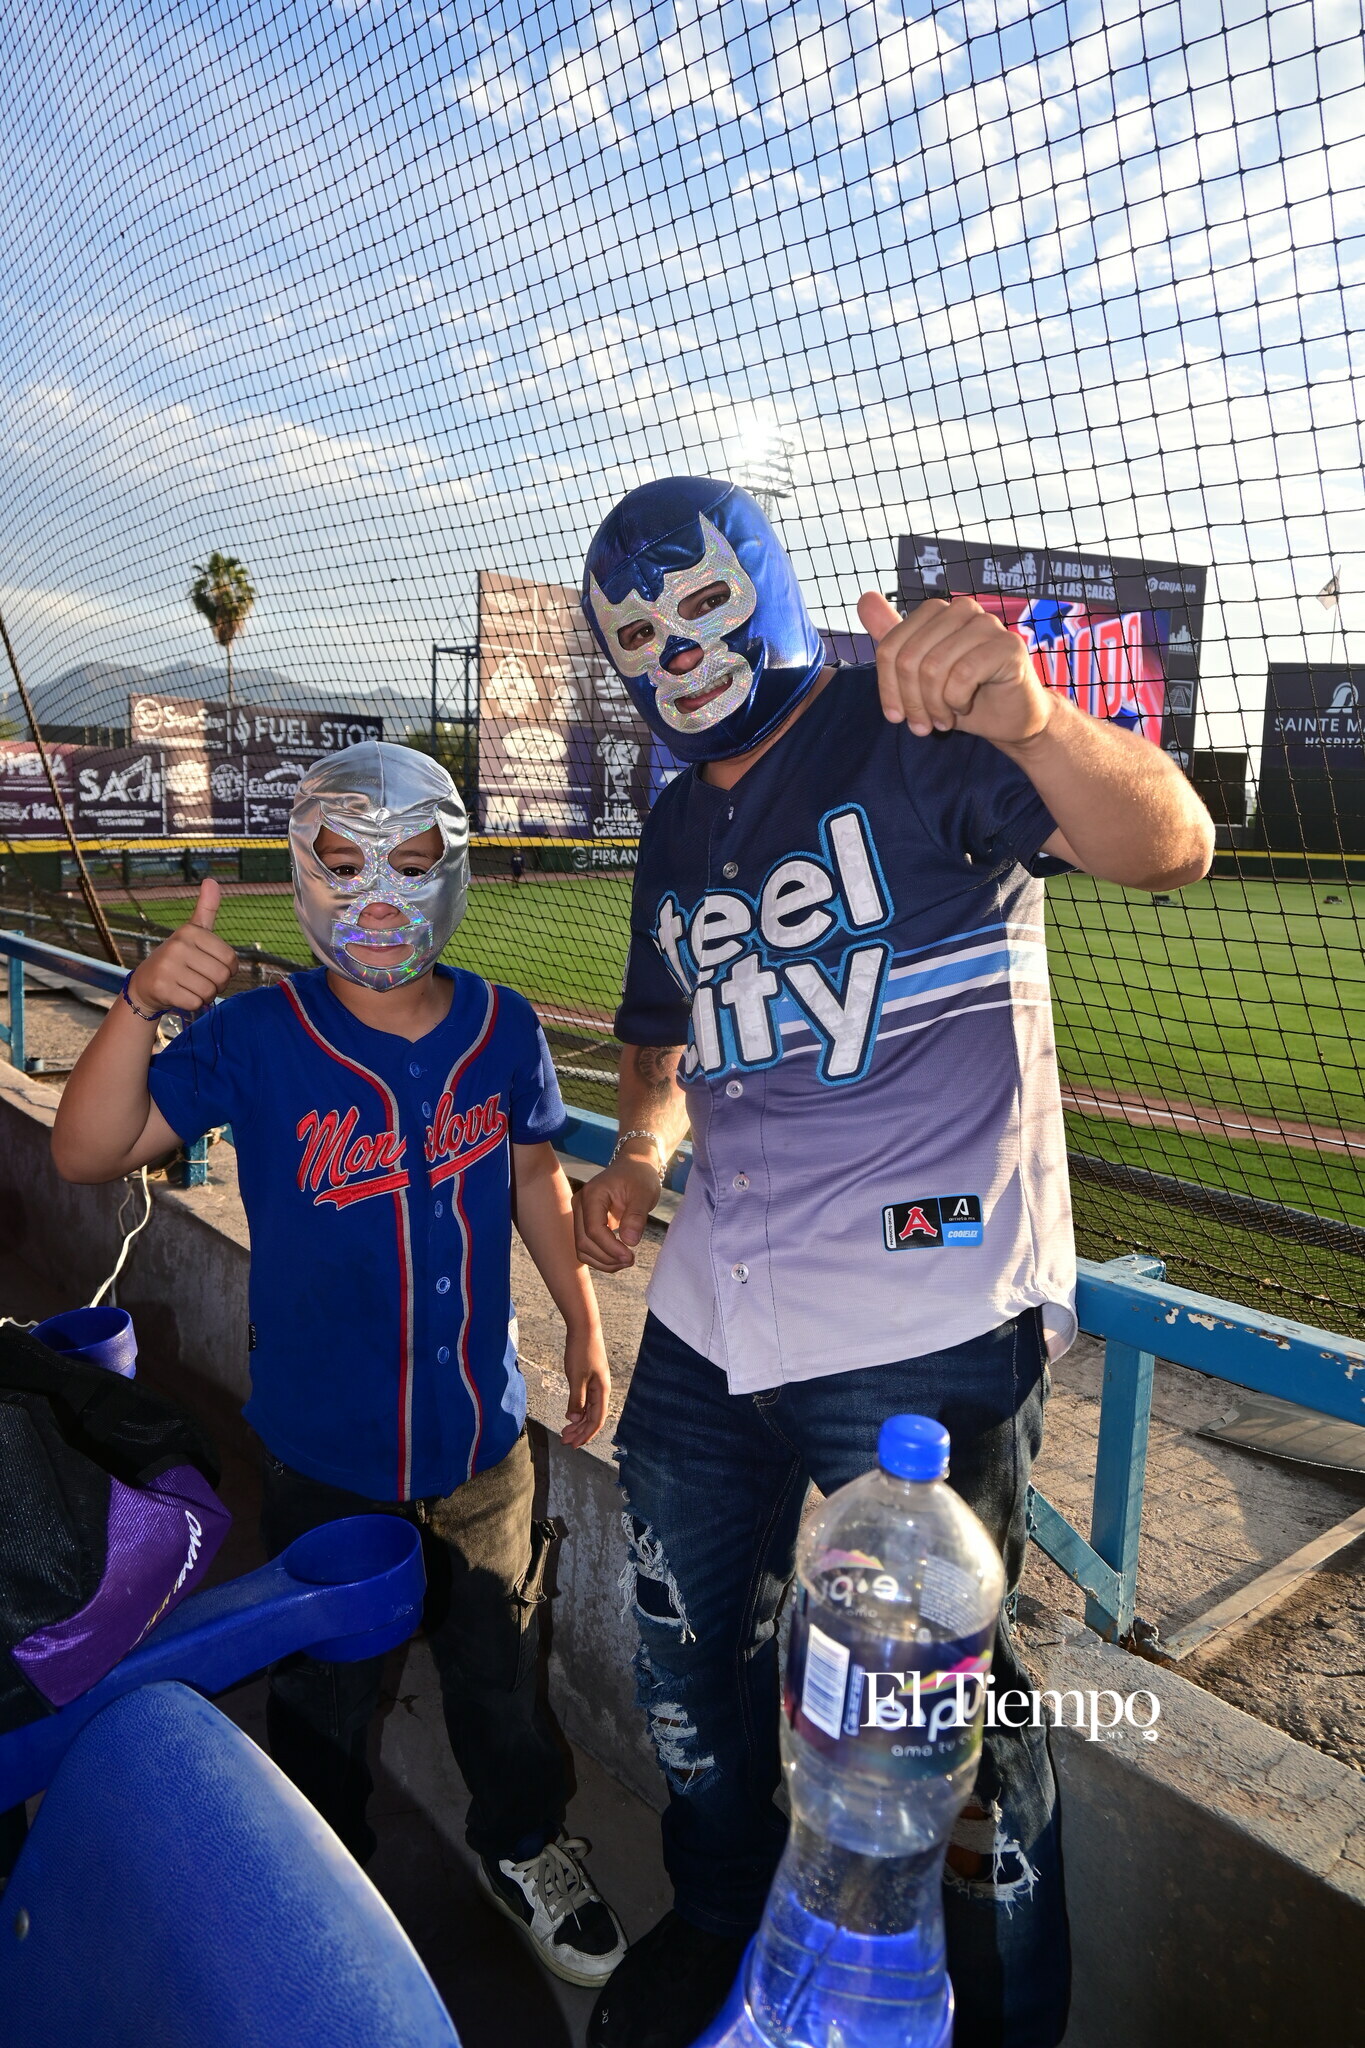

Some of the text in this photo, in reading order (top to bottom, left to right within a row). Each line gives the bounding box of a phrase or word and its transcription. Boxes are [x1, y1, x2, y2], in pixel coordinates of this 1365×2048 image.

[1063, 582, 1083, 598] LAS
[1085, 584, 1116, 601] CALES
[1158, 581, 1197, 593] GRIJAVA
[254, 715, 314, 746] FUEL
[320, 721, 380, 748] STOP
[1274, 717, 1365, 733] SAINTE M
[652, 802, 895, 997] teel
[684, 939, 894, 1088] ity
